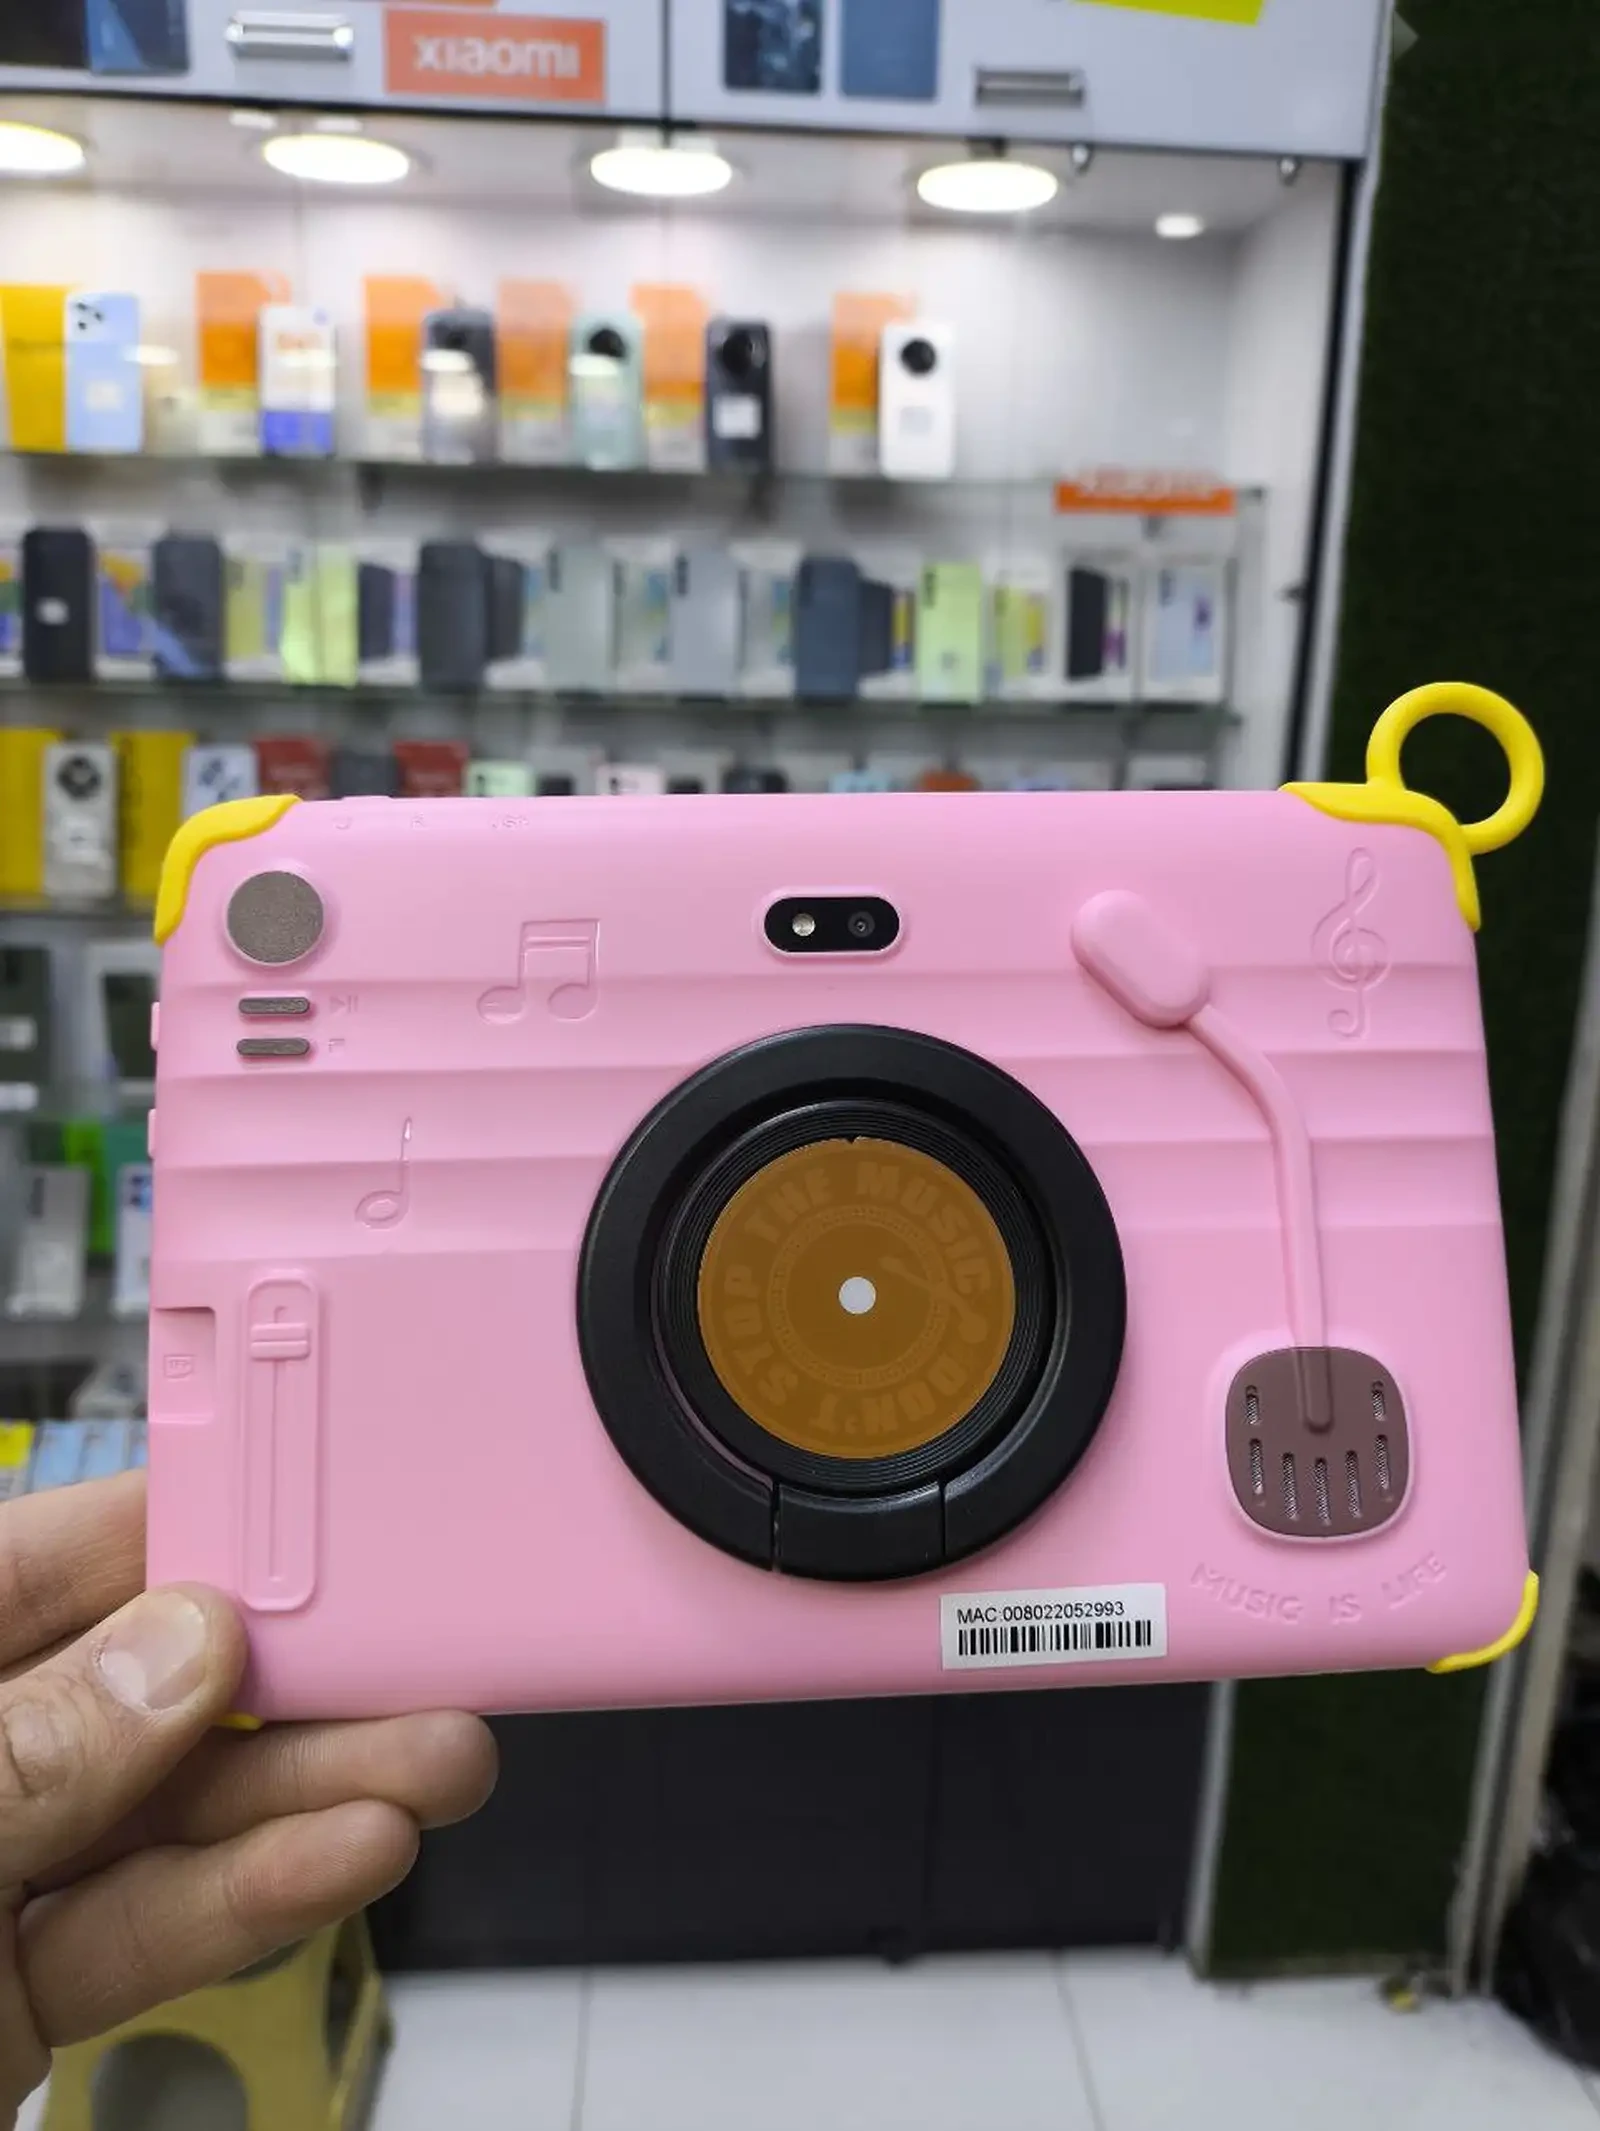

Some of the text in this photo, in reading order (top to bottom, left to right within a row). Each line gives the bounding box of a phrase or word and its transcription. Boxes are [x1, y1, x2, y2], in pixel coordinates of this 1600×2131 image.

[412, 34, 580, 79] xiaomi
[744, 1167, 834, 1244] THE
[856, 1161, 991, 1294] MUSIC
[724, 1264, 799, 1406] STOP
[1189, 1561, 1304, 1625] MUSIC
[1329, 1592, 1363, 1625] IS
